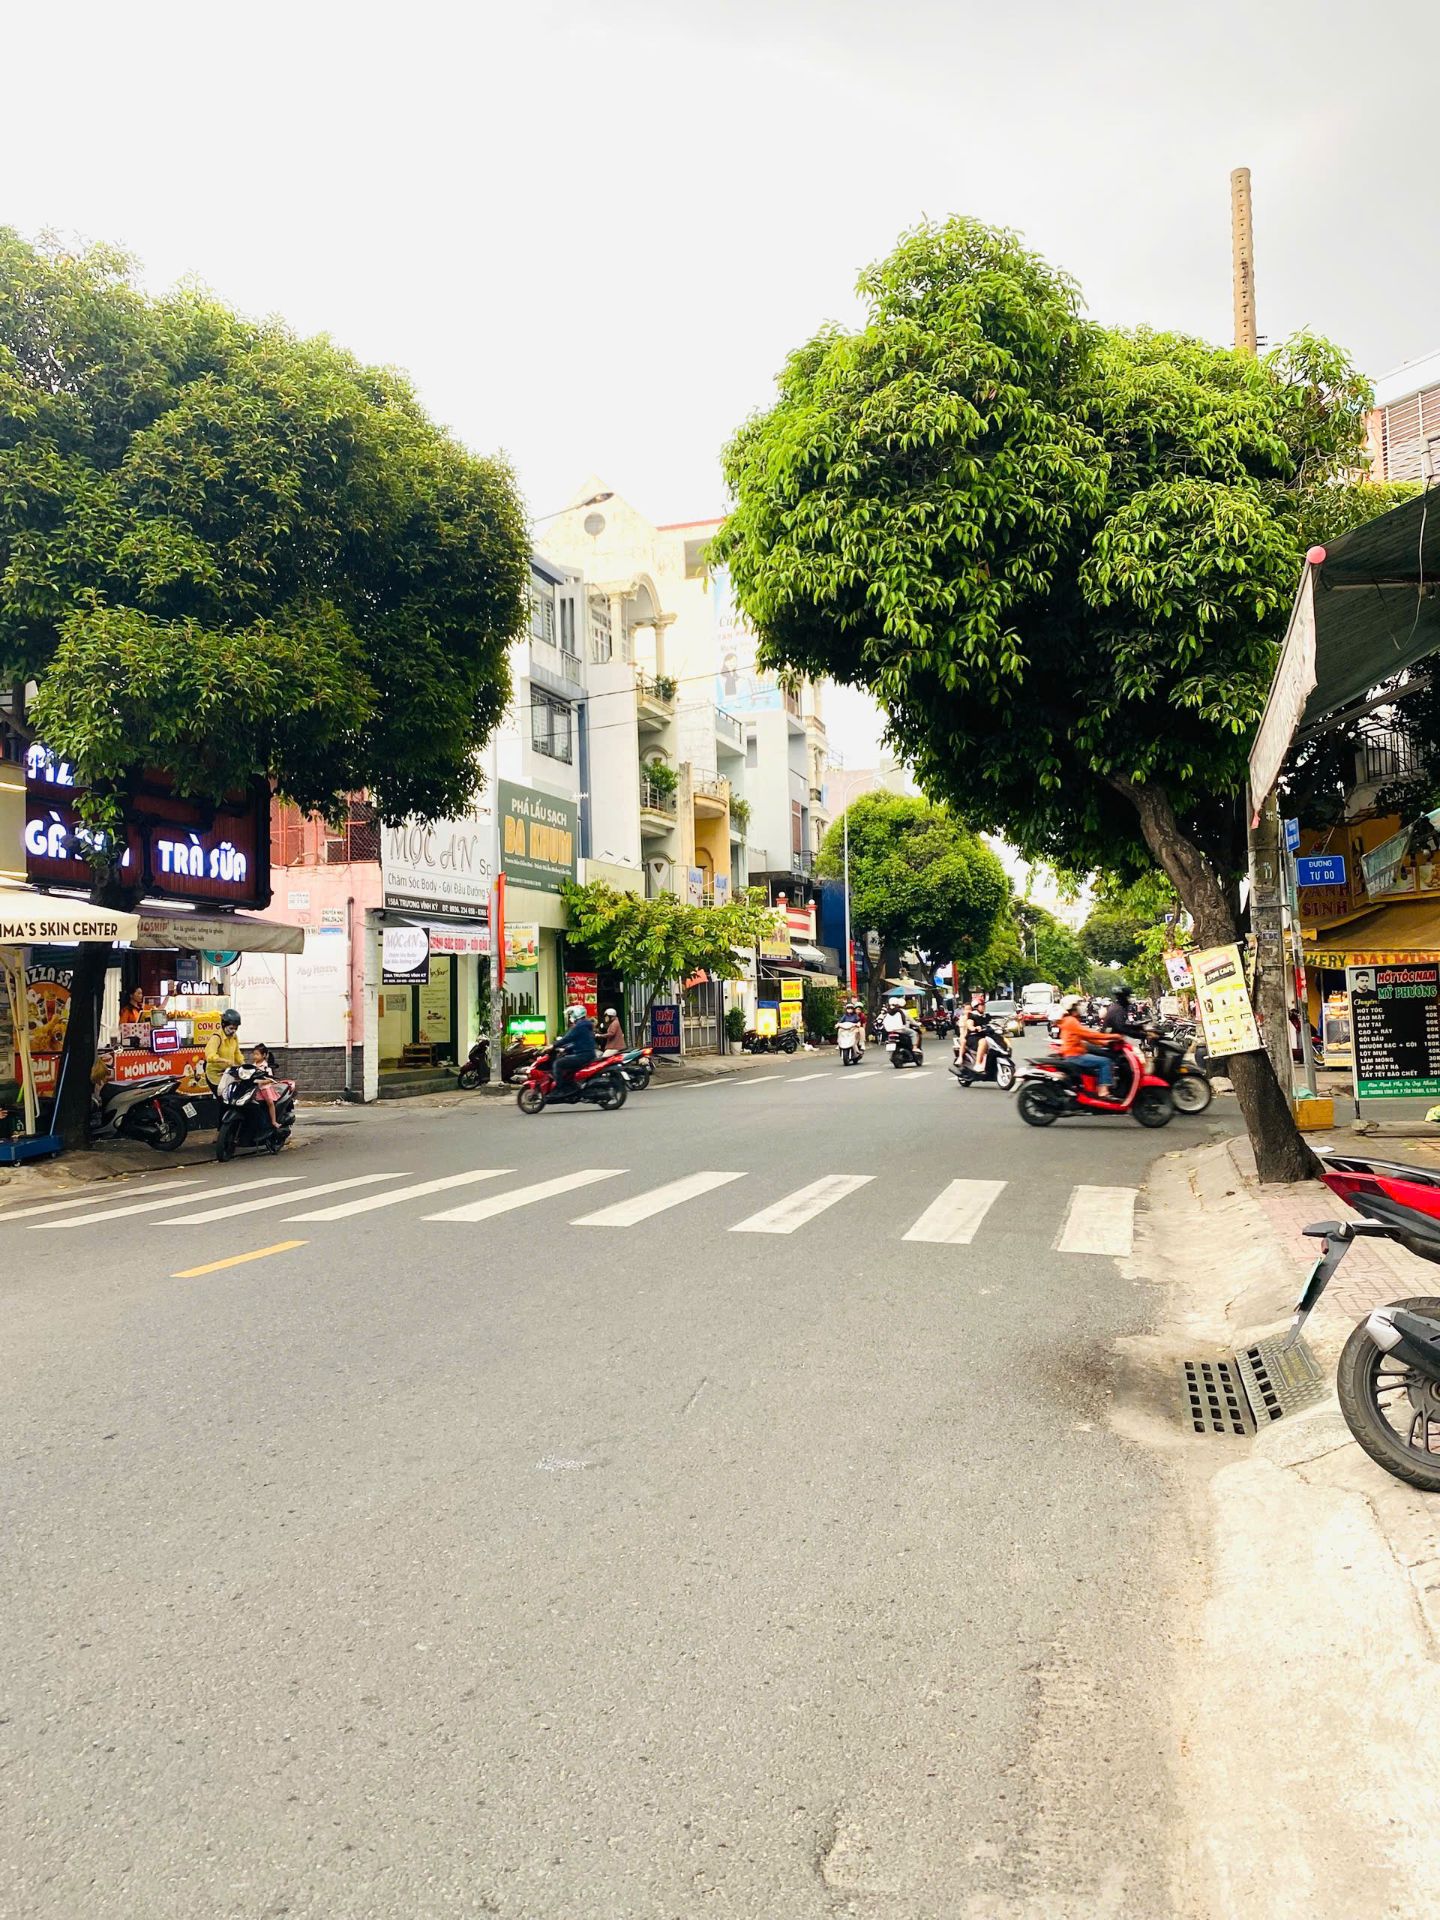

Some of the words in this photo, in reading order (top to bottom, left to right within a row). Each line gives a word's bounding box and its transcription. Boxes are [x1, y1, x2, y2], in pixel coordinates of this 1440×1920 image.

[511, 796, 529, 816] PHÁ
[530, 798, 546, 820] LẤU
[547, 809, 567, 827] SẠCH
[158, 833, 204, 878] TRÀ
[209, 841, 247, 883] SỮA
[1324, 870, 1335, 880] DO
[421, 878, 437, 893] Body
[40, 922, 69, 936] SKIN
[73, 922, 118, 936] CENTER
[1397, 968, 1414, 983] TÓC
[1414, 970, 1437, 982] NAM
[181, 981, 193, 995] GÀ
[1378, 984, 1393, 999] MỸ
